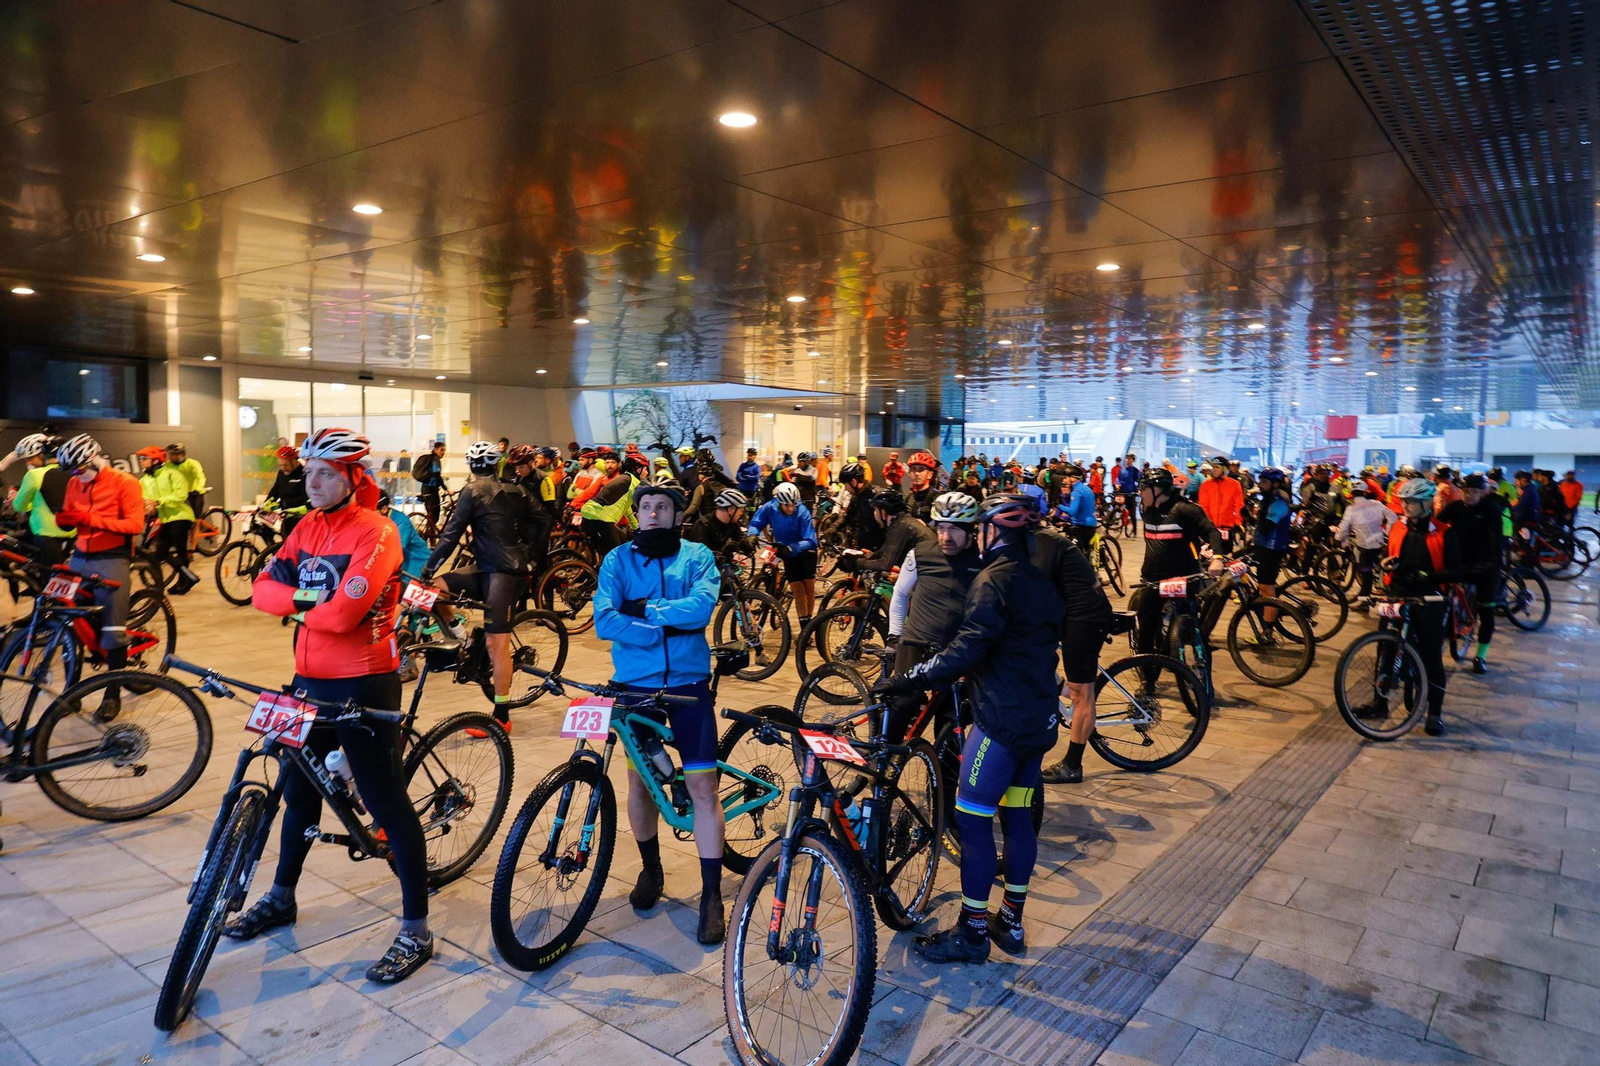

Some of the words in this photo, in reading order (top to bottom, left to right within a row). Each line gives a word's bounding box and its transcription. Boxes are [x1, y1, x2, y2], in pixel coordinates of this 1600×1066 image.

[410, 589, 432, 604] 122
[1163, 583, 1183, 594] 405
[255, 707, 304, 738] 364
[570, 710, 603, 732] 123
[301, 744, 337, 796] CUBE
[539, 942, 567, 965] MAXXIS
